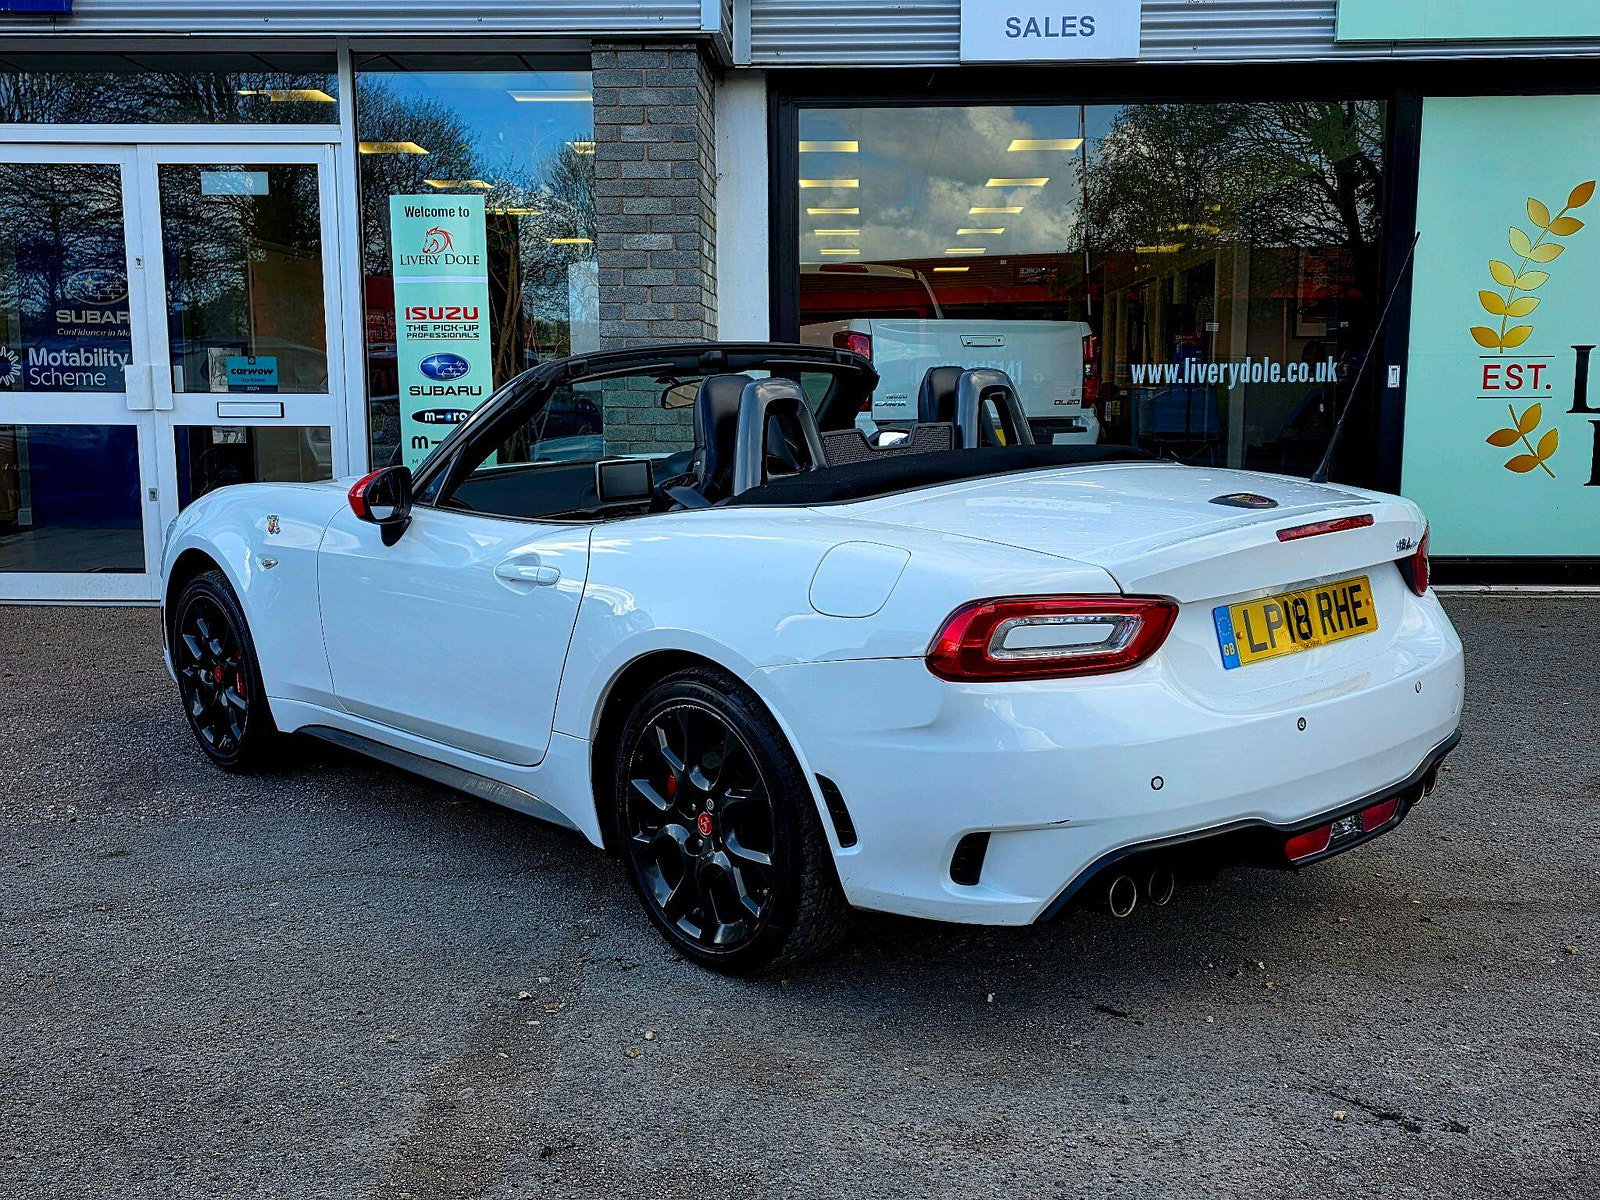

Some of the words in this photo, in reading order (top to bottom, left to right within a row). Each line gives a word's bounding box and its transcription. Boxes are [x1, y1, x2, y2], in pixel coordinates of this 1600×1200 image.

[1005, 15, 1095, 38] SALES
[404, 206, 455, 218] Welcome
[458, 206, 470, 218] to
[400, 254, 440, 266] LIVERY
[445, 253, 480, 265] DOLE
[56, 309, 131, 324] SUBAR
[405, 307, 479, 320] ISUZU
[57, 328, 106, 337] Confidence
[108, 328, 117, 337] in
[433, 324, 479, 332] PICK-UP
[28, 348, 129, 371] Motability
[29, 367, 106, 386] Scheme
[1131, 355, 1338, 390] www.liverydole.co.uk
[1482, 363, 1552, 390] EST.
[409, 385, 482, 396] SUBARU
[1242, 597, 1313, 654] LP18
[1315, 584, 1368, 636] RHE
[1223, 642, 1236, 657] GB
